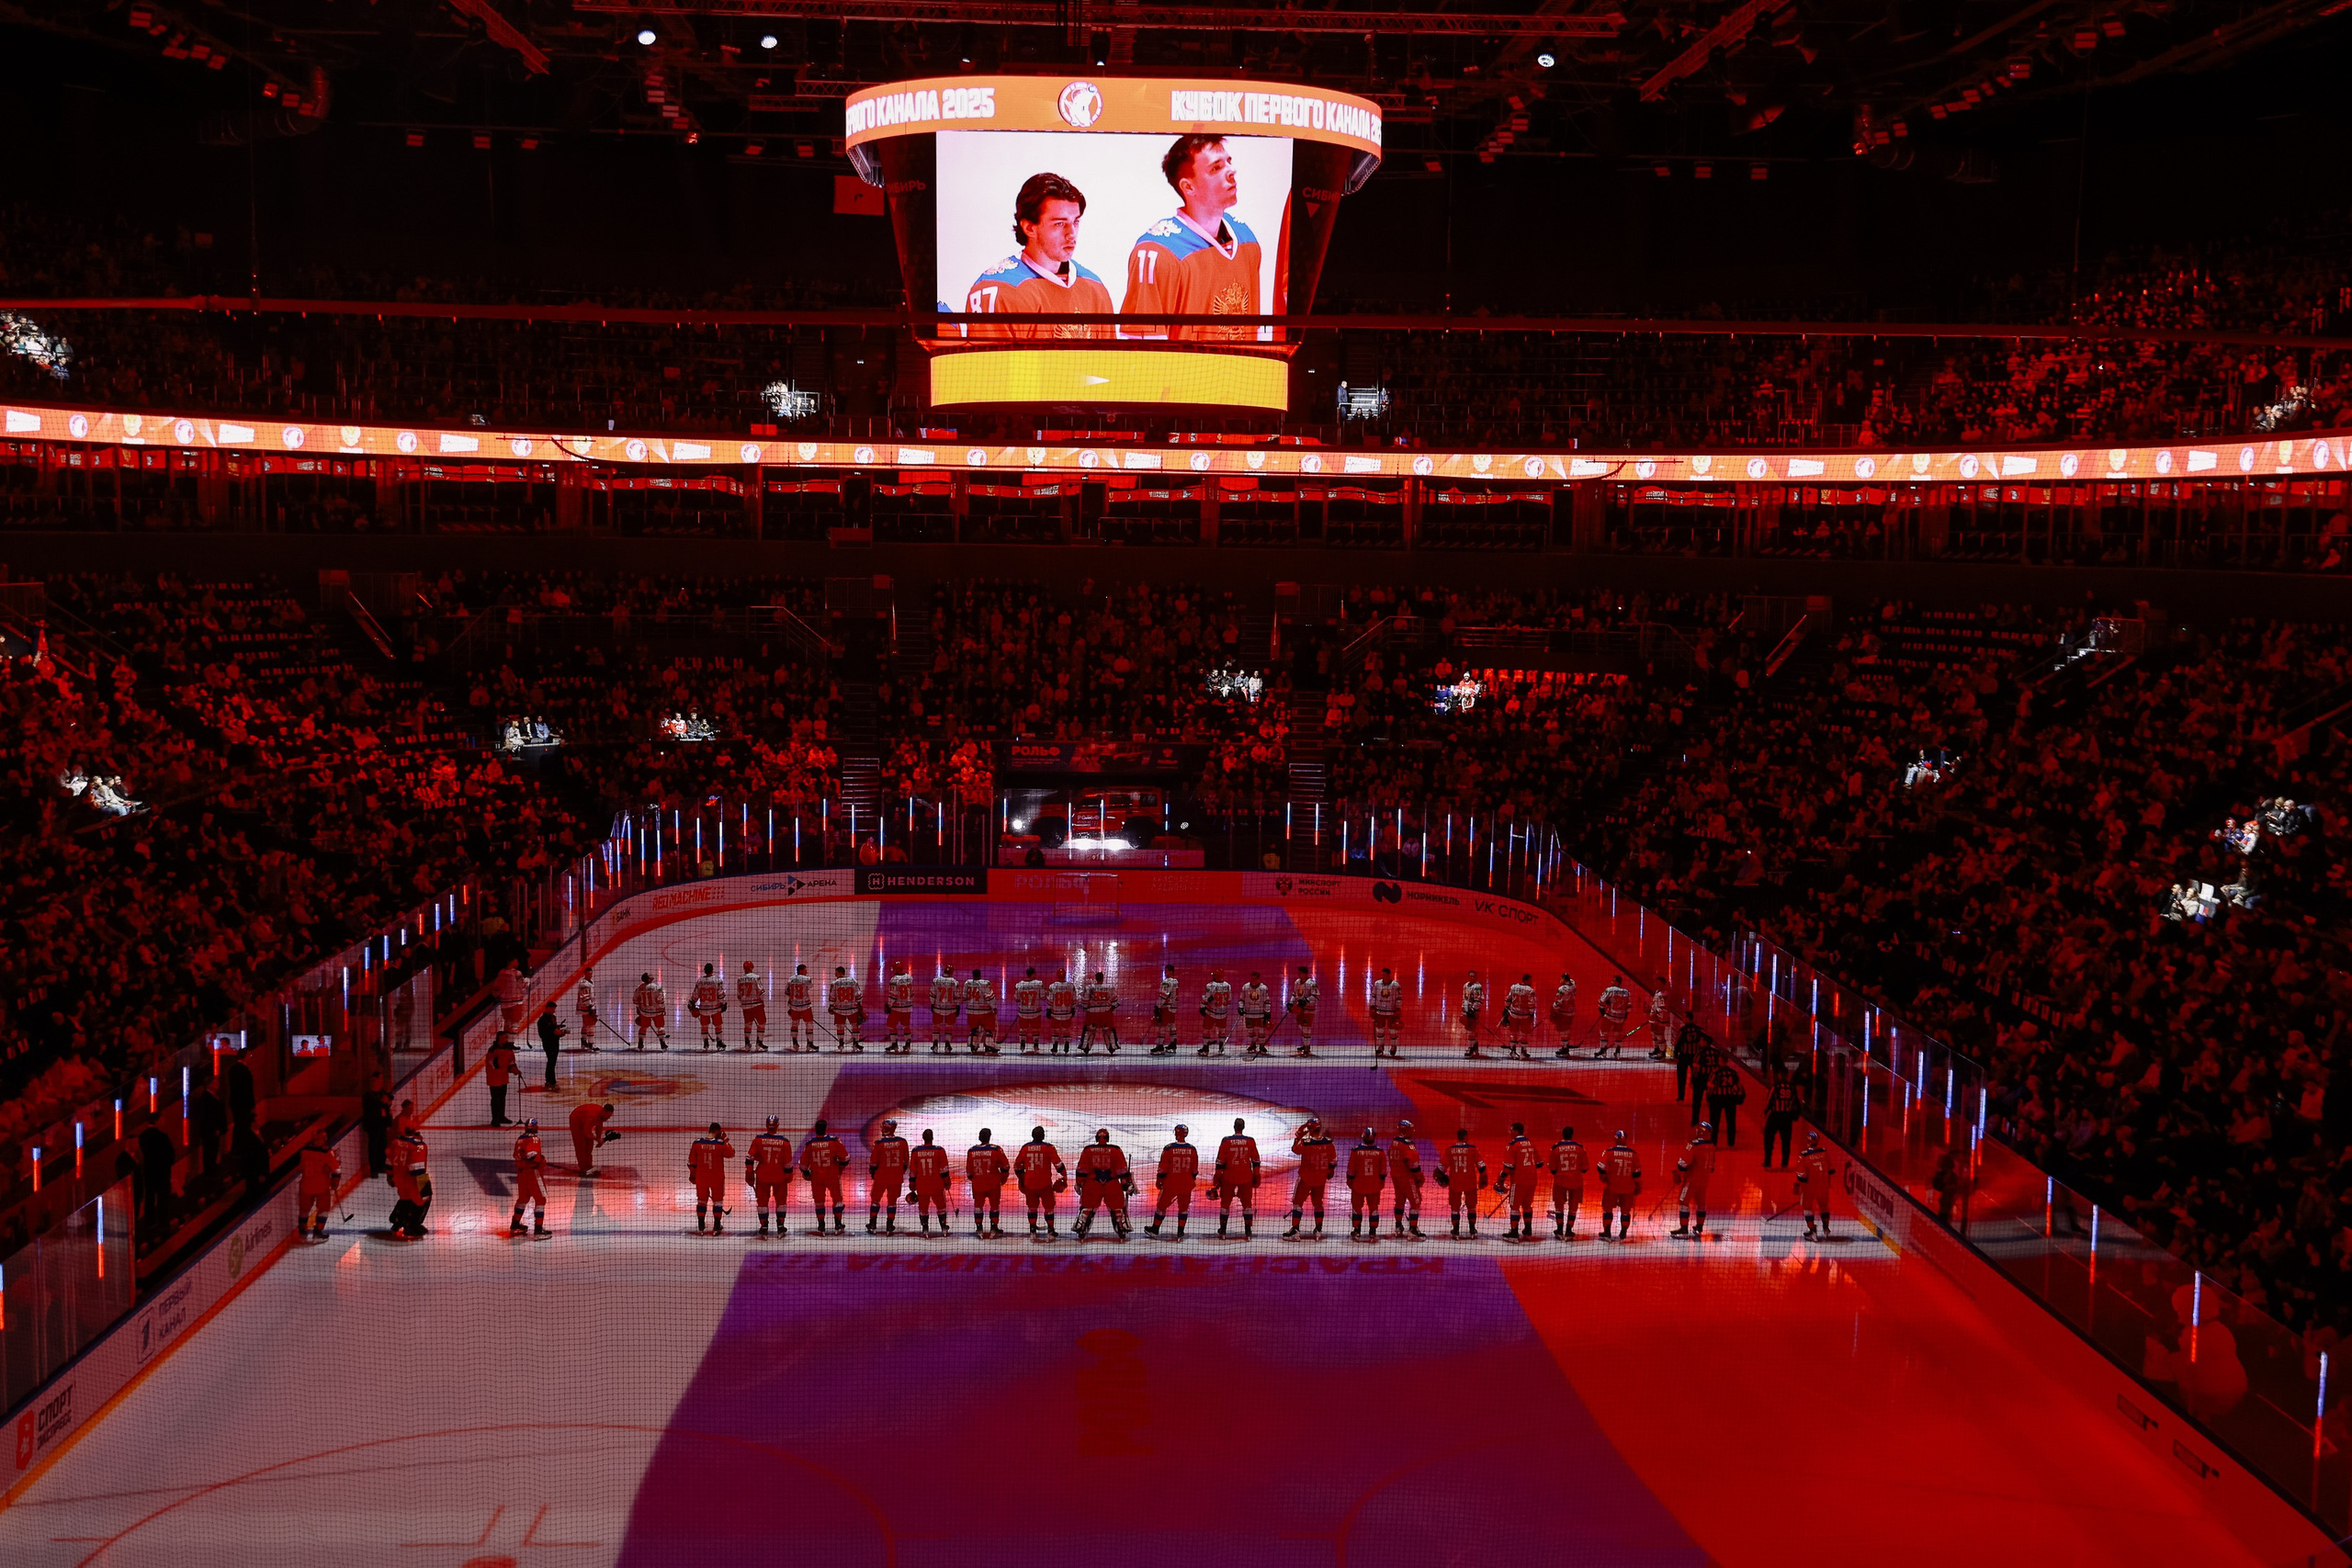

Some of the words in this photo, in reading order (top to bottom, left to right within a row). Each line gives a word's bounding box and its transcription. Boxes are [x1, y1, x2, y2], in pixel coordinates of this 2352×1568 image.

[876, 89, 940, 128] КАНАЛА
[942, 87, 996, 118] 2025
[1171, 90, 1244, 122] КУБОК
[1244, 92, 1325, 130] ПЕРВОГО
[1326, 101, 1370, 141] КАНАЛА
[1302, 186, 1341, 202] СИБИР
[1137, 249, 1159, 285] 11
[969, 286, 998, 313] 87
[1011, 745, 1061, 756] РОЛЬФ
[750, 883, 786, 893] СИБИРЬ
[807, 878, 837, 888] АРЕНА
[888, 875, 975, 887] HENDERSON
[1013, 874, 1089, 890] РОЛЬФ
[1298, 877, 1340, 887] МИНСПОРТ
[652, 895, 669, 911] RED
[669, 886, 711, 908] MACHINE
[1298, 887, 1330, 896] РОССИИ
[1407, 890, 1460, 906] НОРНИКЕЛЬ
[1475, 899, 1494, 914] VK
[1498, 904, 1538, 926] СПОРТ
[992, 1084, 1119, 1097] CHANNEL
[1140, 1088, 1193, 1098] ONE
[703, 1153, 712, 1169] 4
[812, 1150, 831, 1168] 45
[885, 1150, 900, 1167] 13
[1026, 1153, 1044, 1171] 34
[1230, 1147, 1248, 1165] 24
[1453, 1156, 1467, 1173] 14
[921, 1158, 933, 1175] 11
[1364, 1158, 1374, 1176] 6
[159, 1307, 187, 1338] КАНАЛ
[39, 1384, 74, 1432] СПОРТ
